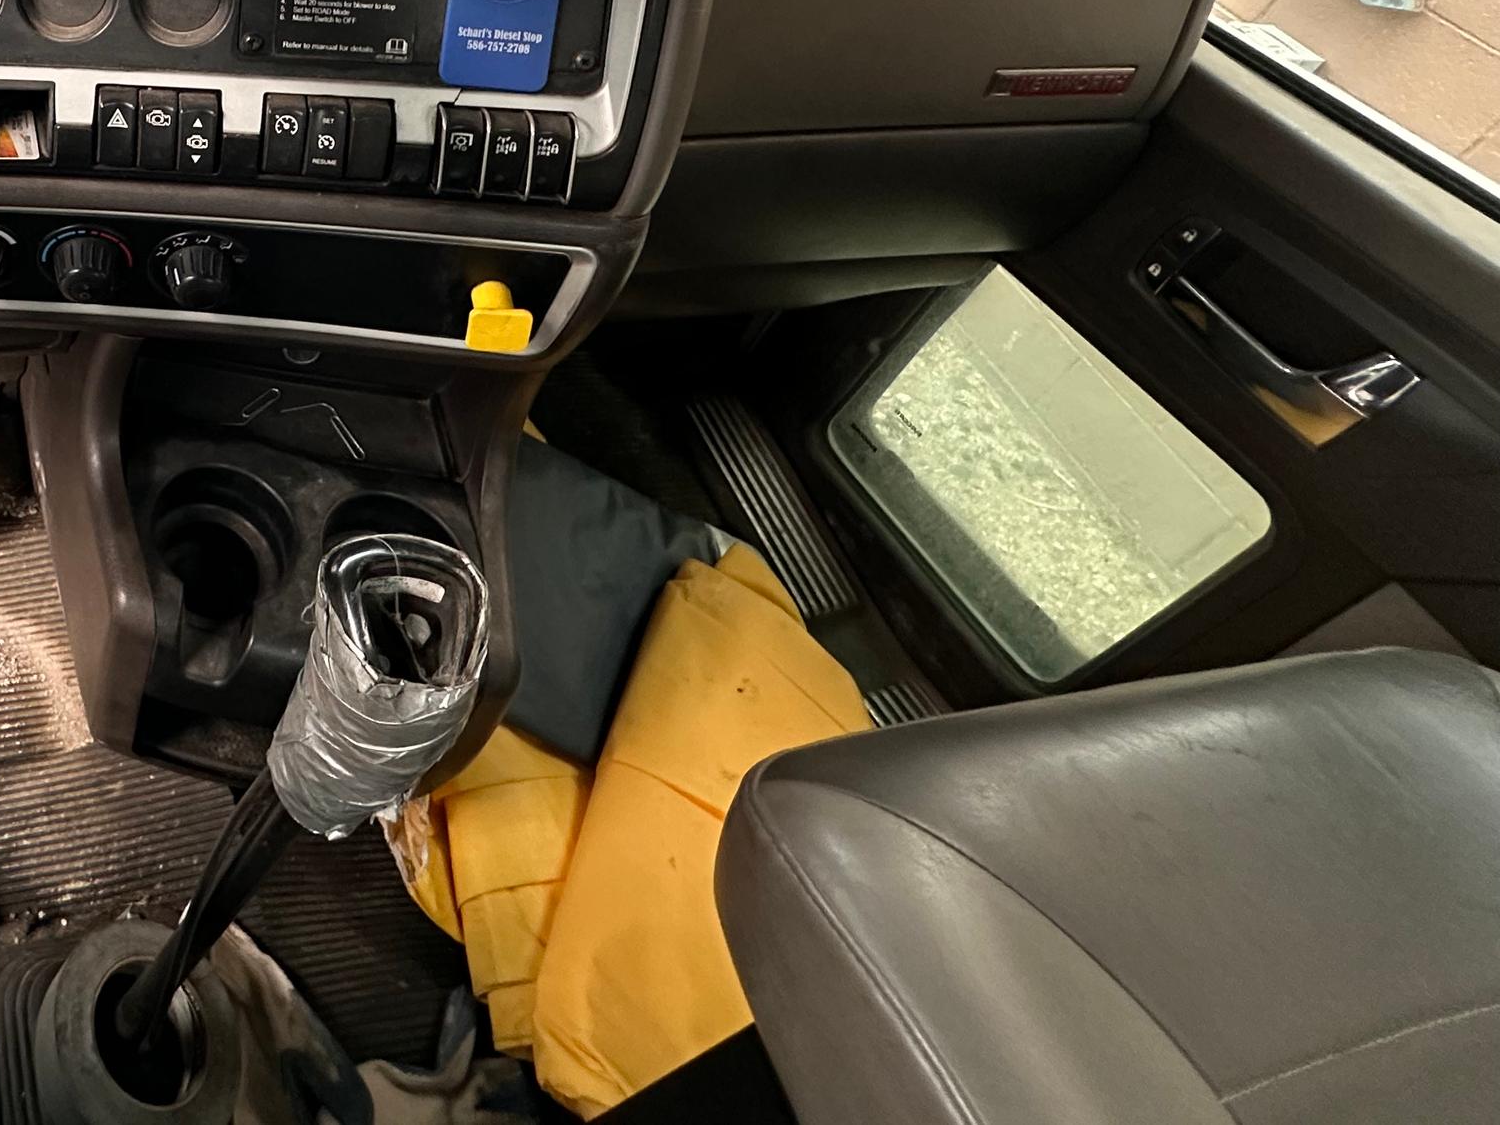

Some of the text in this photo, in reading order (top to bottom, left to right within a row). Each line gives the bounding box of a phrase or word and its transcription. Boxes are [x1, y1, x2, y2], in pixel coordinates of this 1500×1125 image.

[382, 3, 396, 11] stop
[292, 14, 313, 22] Master
[314, 15, 334, 23] Switch
[494, 29, 521, 41] Diesel
[522, 31, 542, 44] Stop
[312, 158, 337, 166] RESUME
